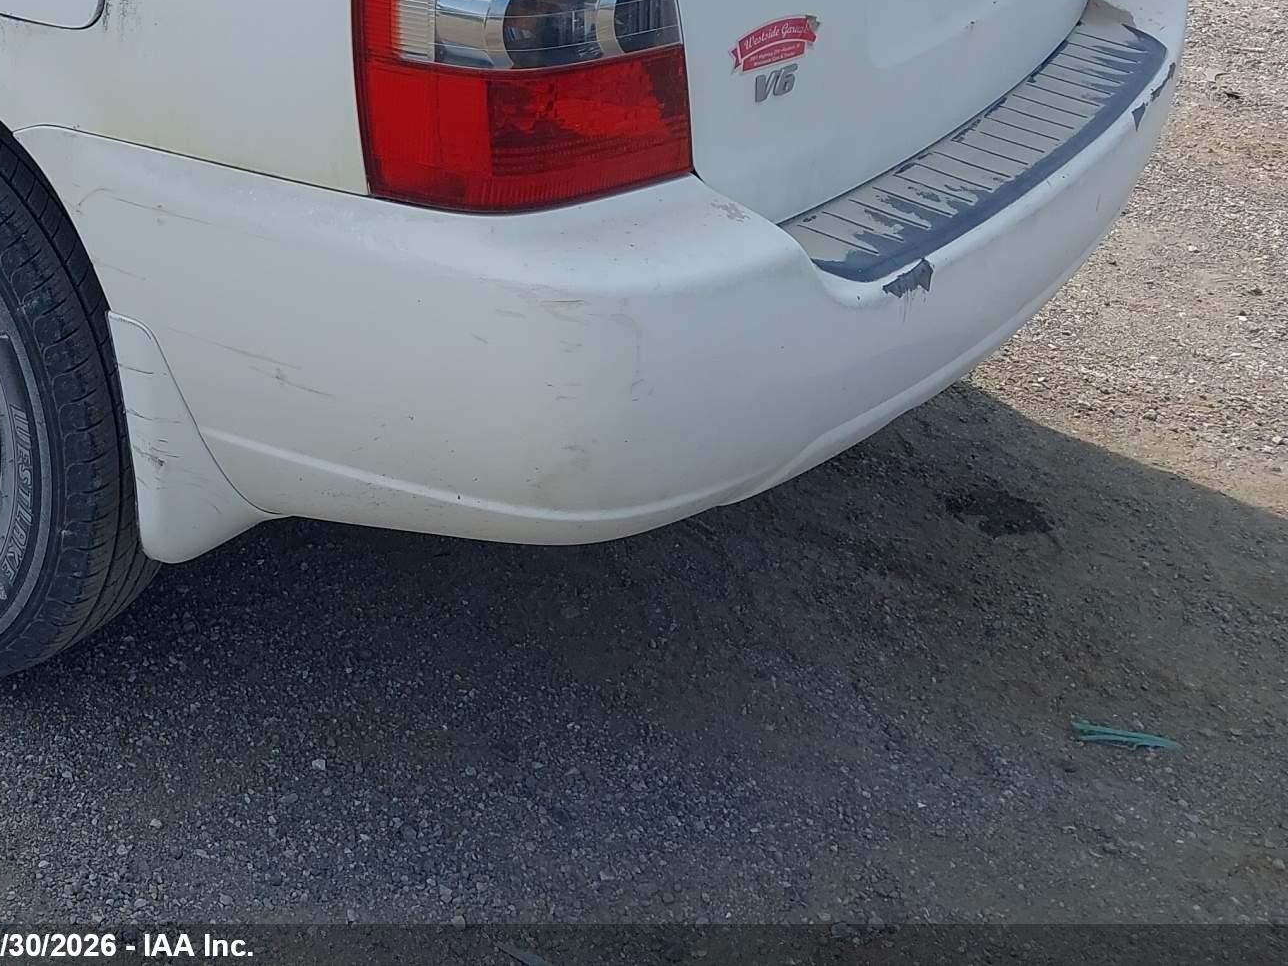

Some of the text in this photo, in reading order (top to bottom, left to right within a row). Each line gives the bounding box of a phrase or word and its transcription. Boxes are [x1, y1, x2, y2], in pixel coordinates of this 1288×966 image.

[744, 25, 780, 50] Westside
[755, 63, 799, 103] V6
[1, 403, 35, 586] WESTLAKE
